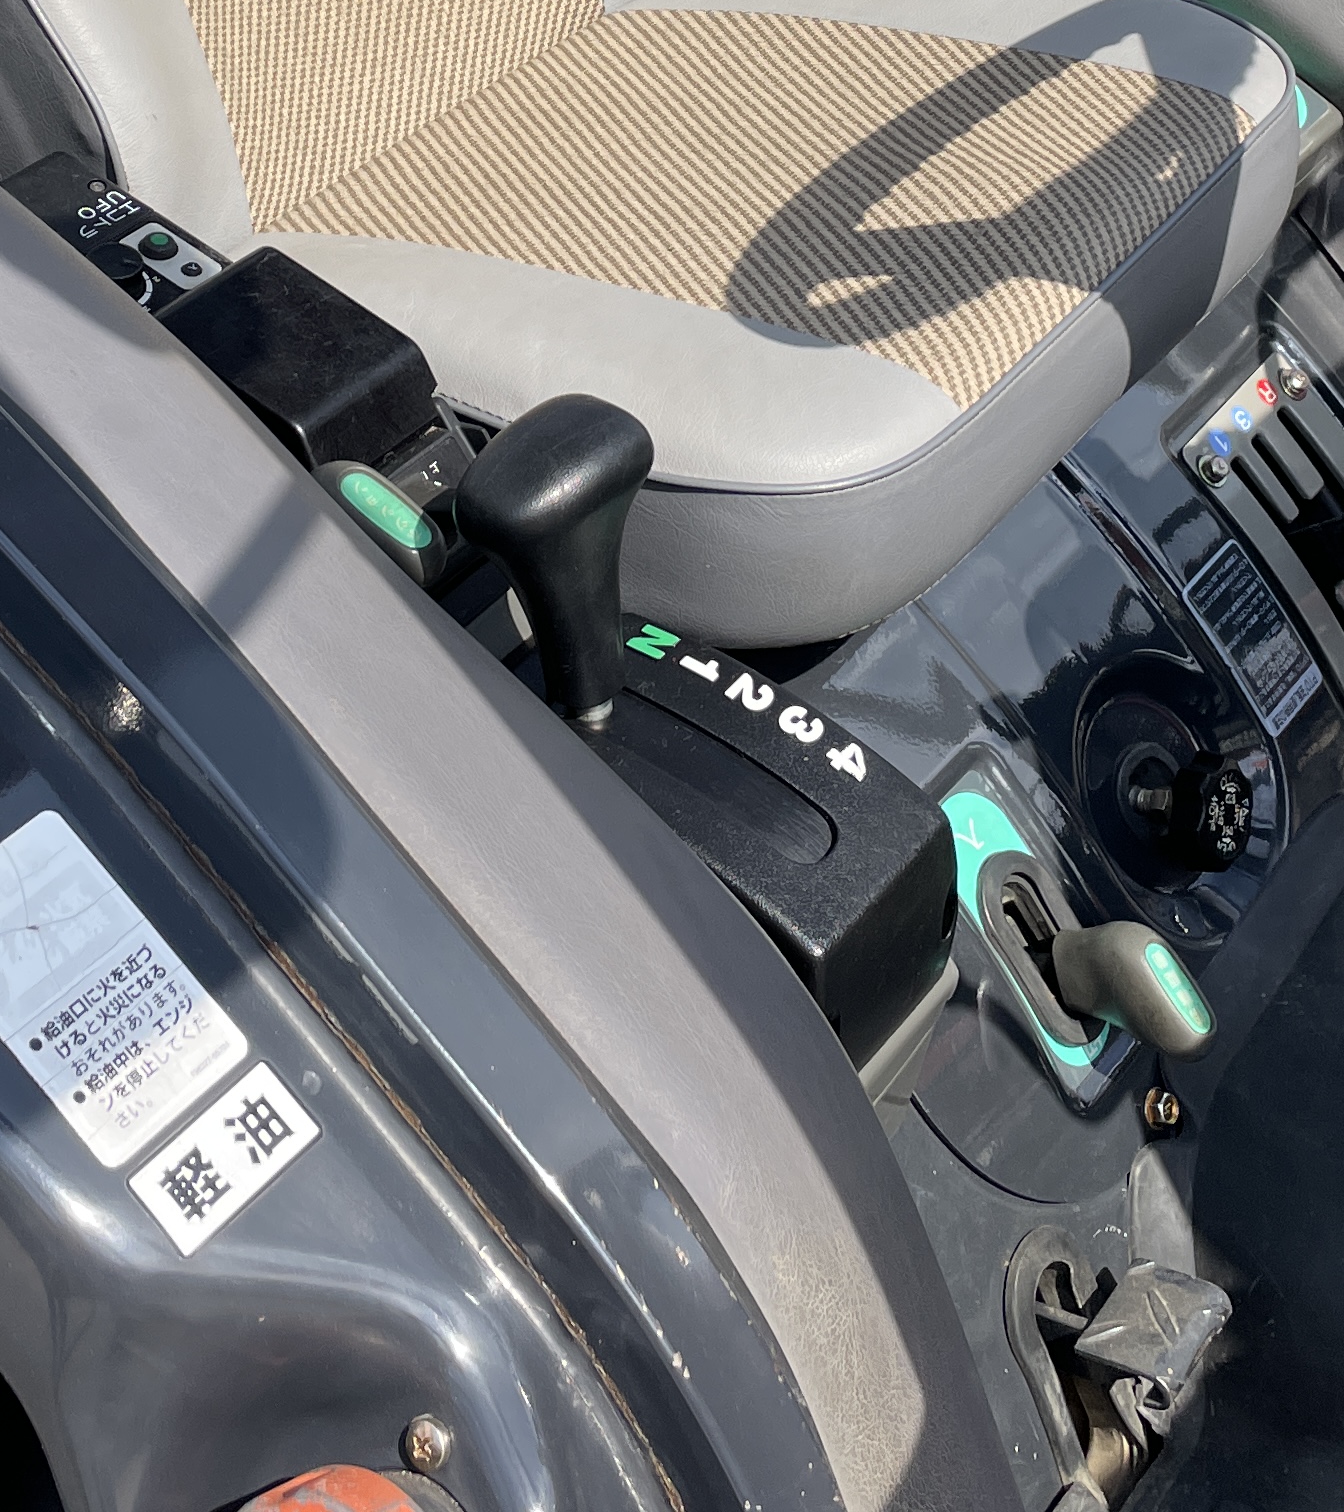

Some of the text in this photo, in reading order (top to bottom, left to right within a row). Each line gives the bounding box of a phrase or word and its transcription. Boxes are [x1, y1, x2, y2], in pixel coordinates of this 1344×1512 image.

[78, 190, 127, 219] UFO
[80, 201, 141, 239] エコトラ
[1234, 410, 1251, 430] 3
[1212, 433, 1229, 452] 1
[626, 623, 682, 660] N
[679, 655, 720, 683] 1
[724, 671, 775, 713] 2
[778, 705, 825, 745] 3
[826, 743, 868, 783] 4
[42, 943, 155, 1041] 給油口に火を近づ
[54, 965, 167, 1061] けると火災になる
[70, 983, 188, 1076] おそれがあります。
[98, 1014, 210, 1112] ンを停止してくだ
[160, 1092, 297, 1222] 軽油
